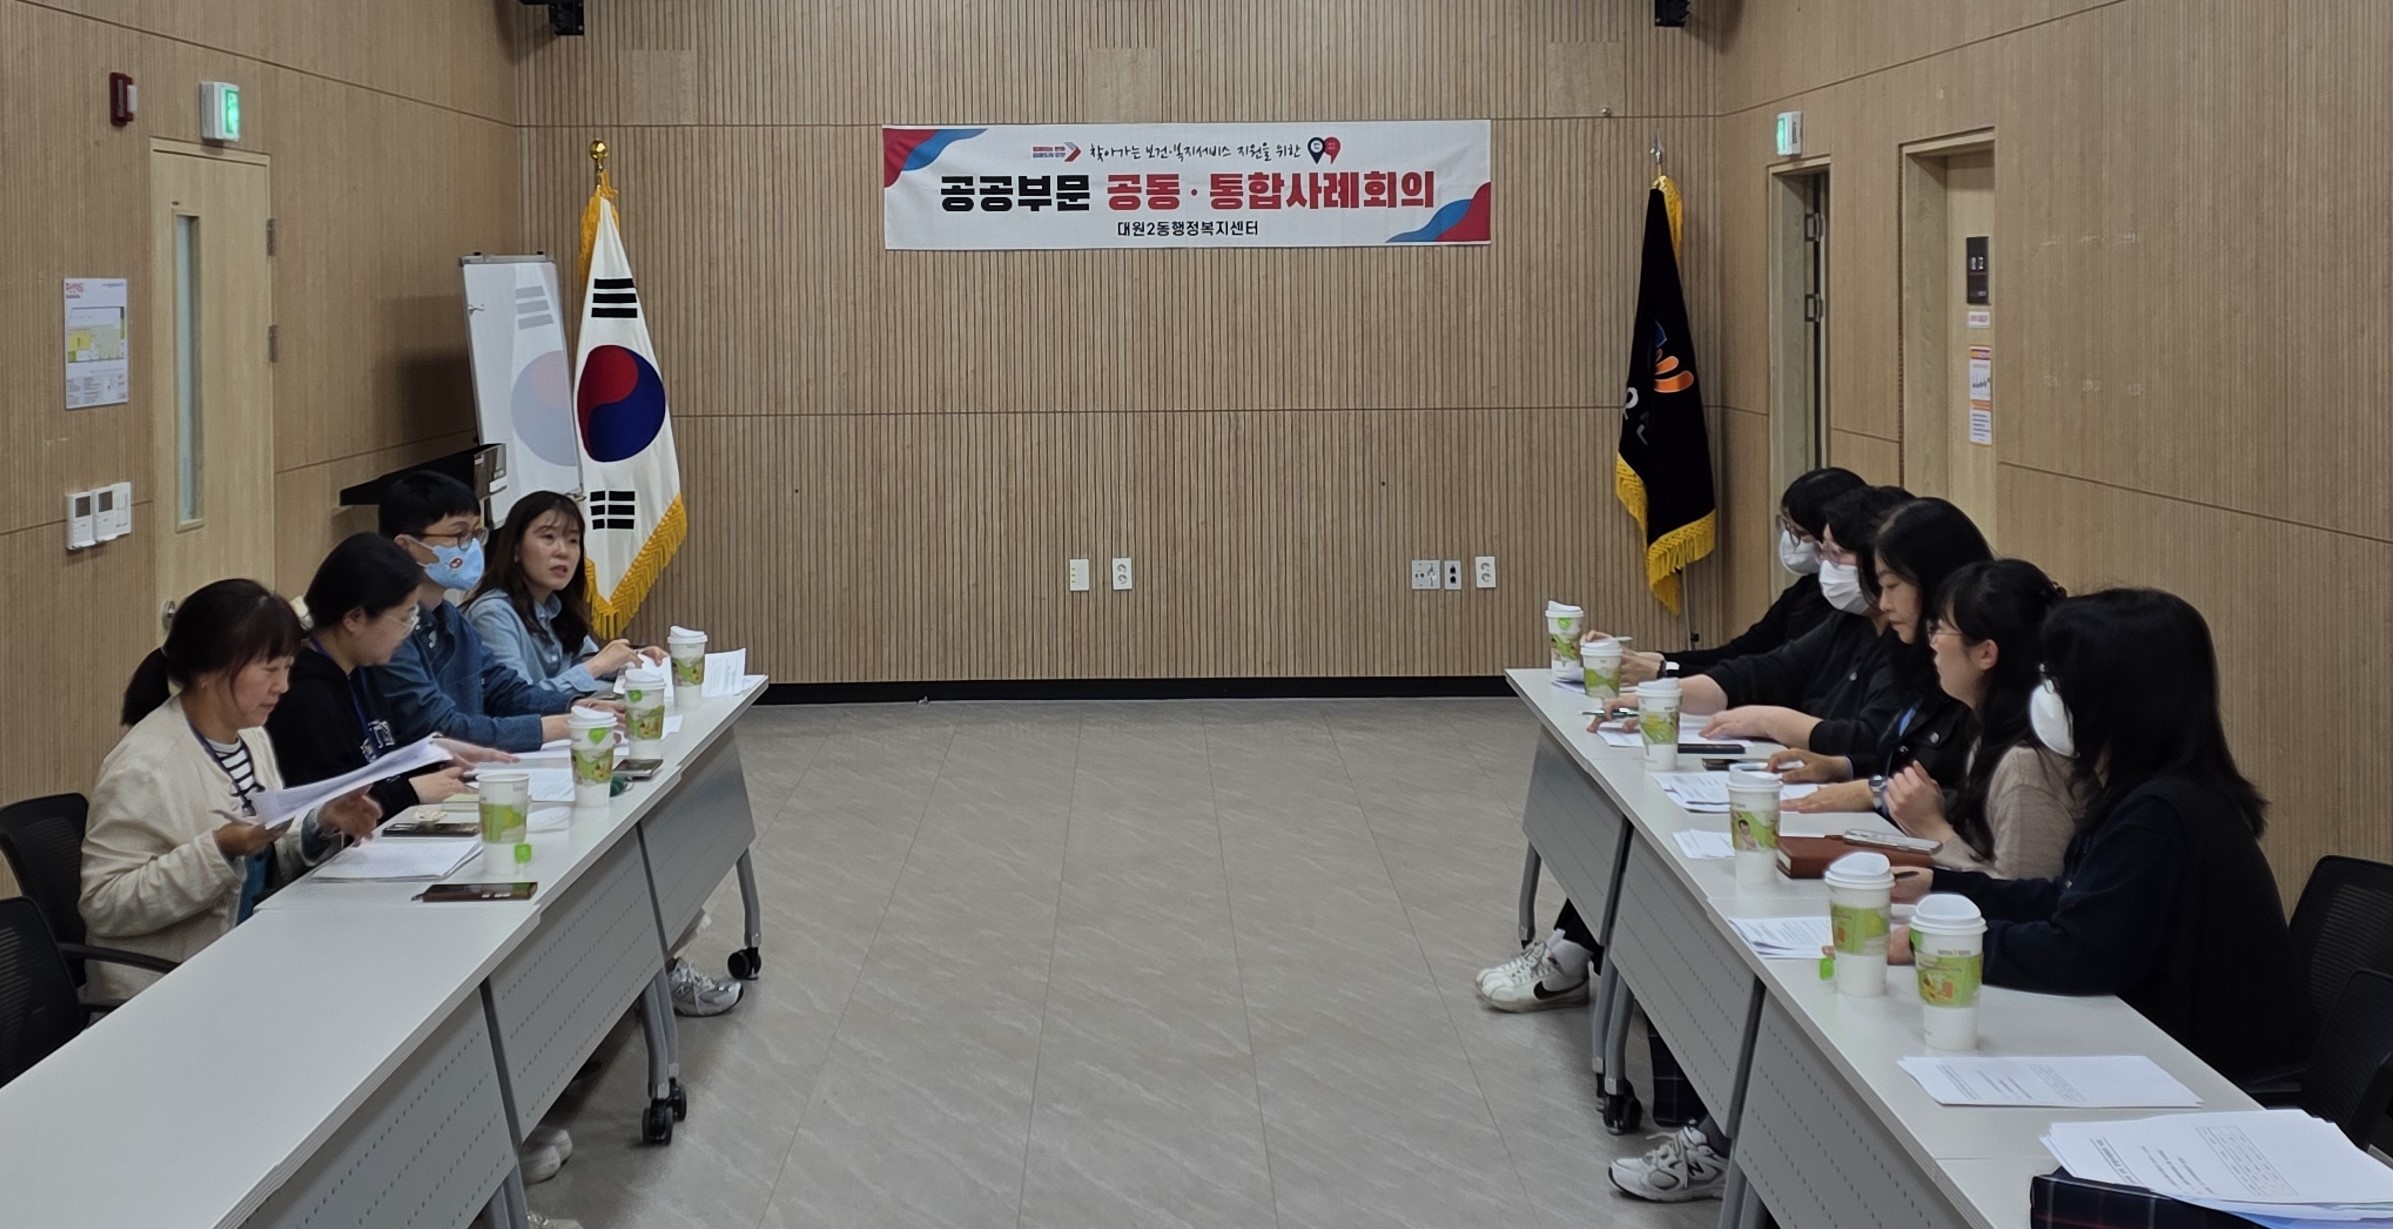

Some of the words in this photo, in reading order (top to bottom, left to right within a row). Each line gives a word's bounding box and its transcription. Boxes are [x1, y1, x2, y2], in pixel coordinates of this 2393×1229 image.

[1090, 142, 1141, 161] 찾아가는
[1237, 142, 1271, 162] 지원을
[1276, 143, 1301, 158] 위한
[940, 174, 1091, 212] 공공부문
[1117, 220, 1259, 237] 대원2동행정복지센터
